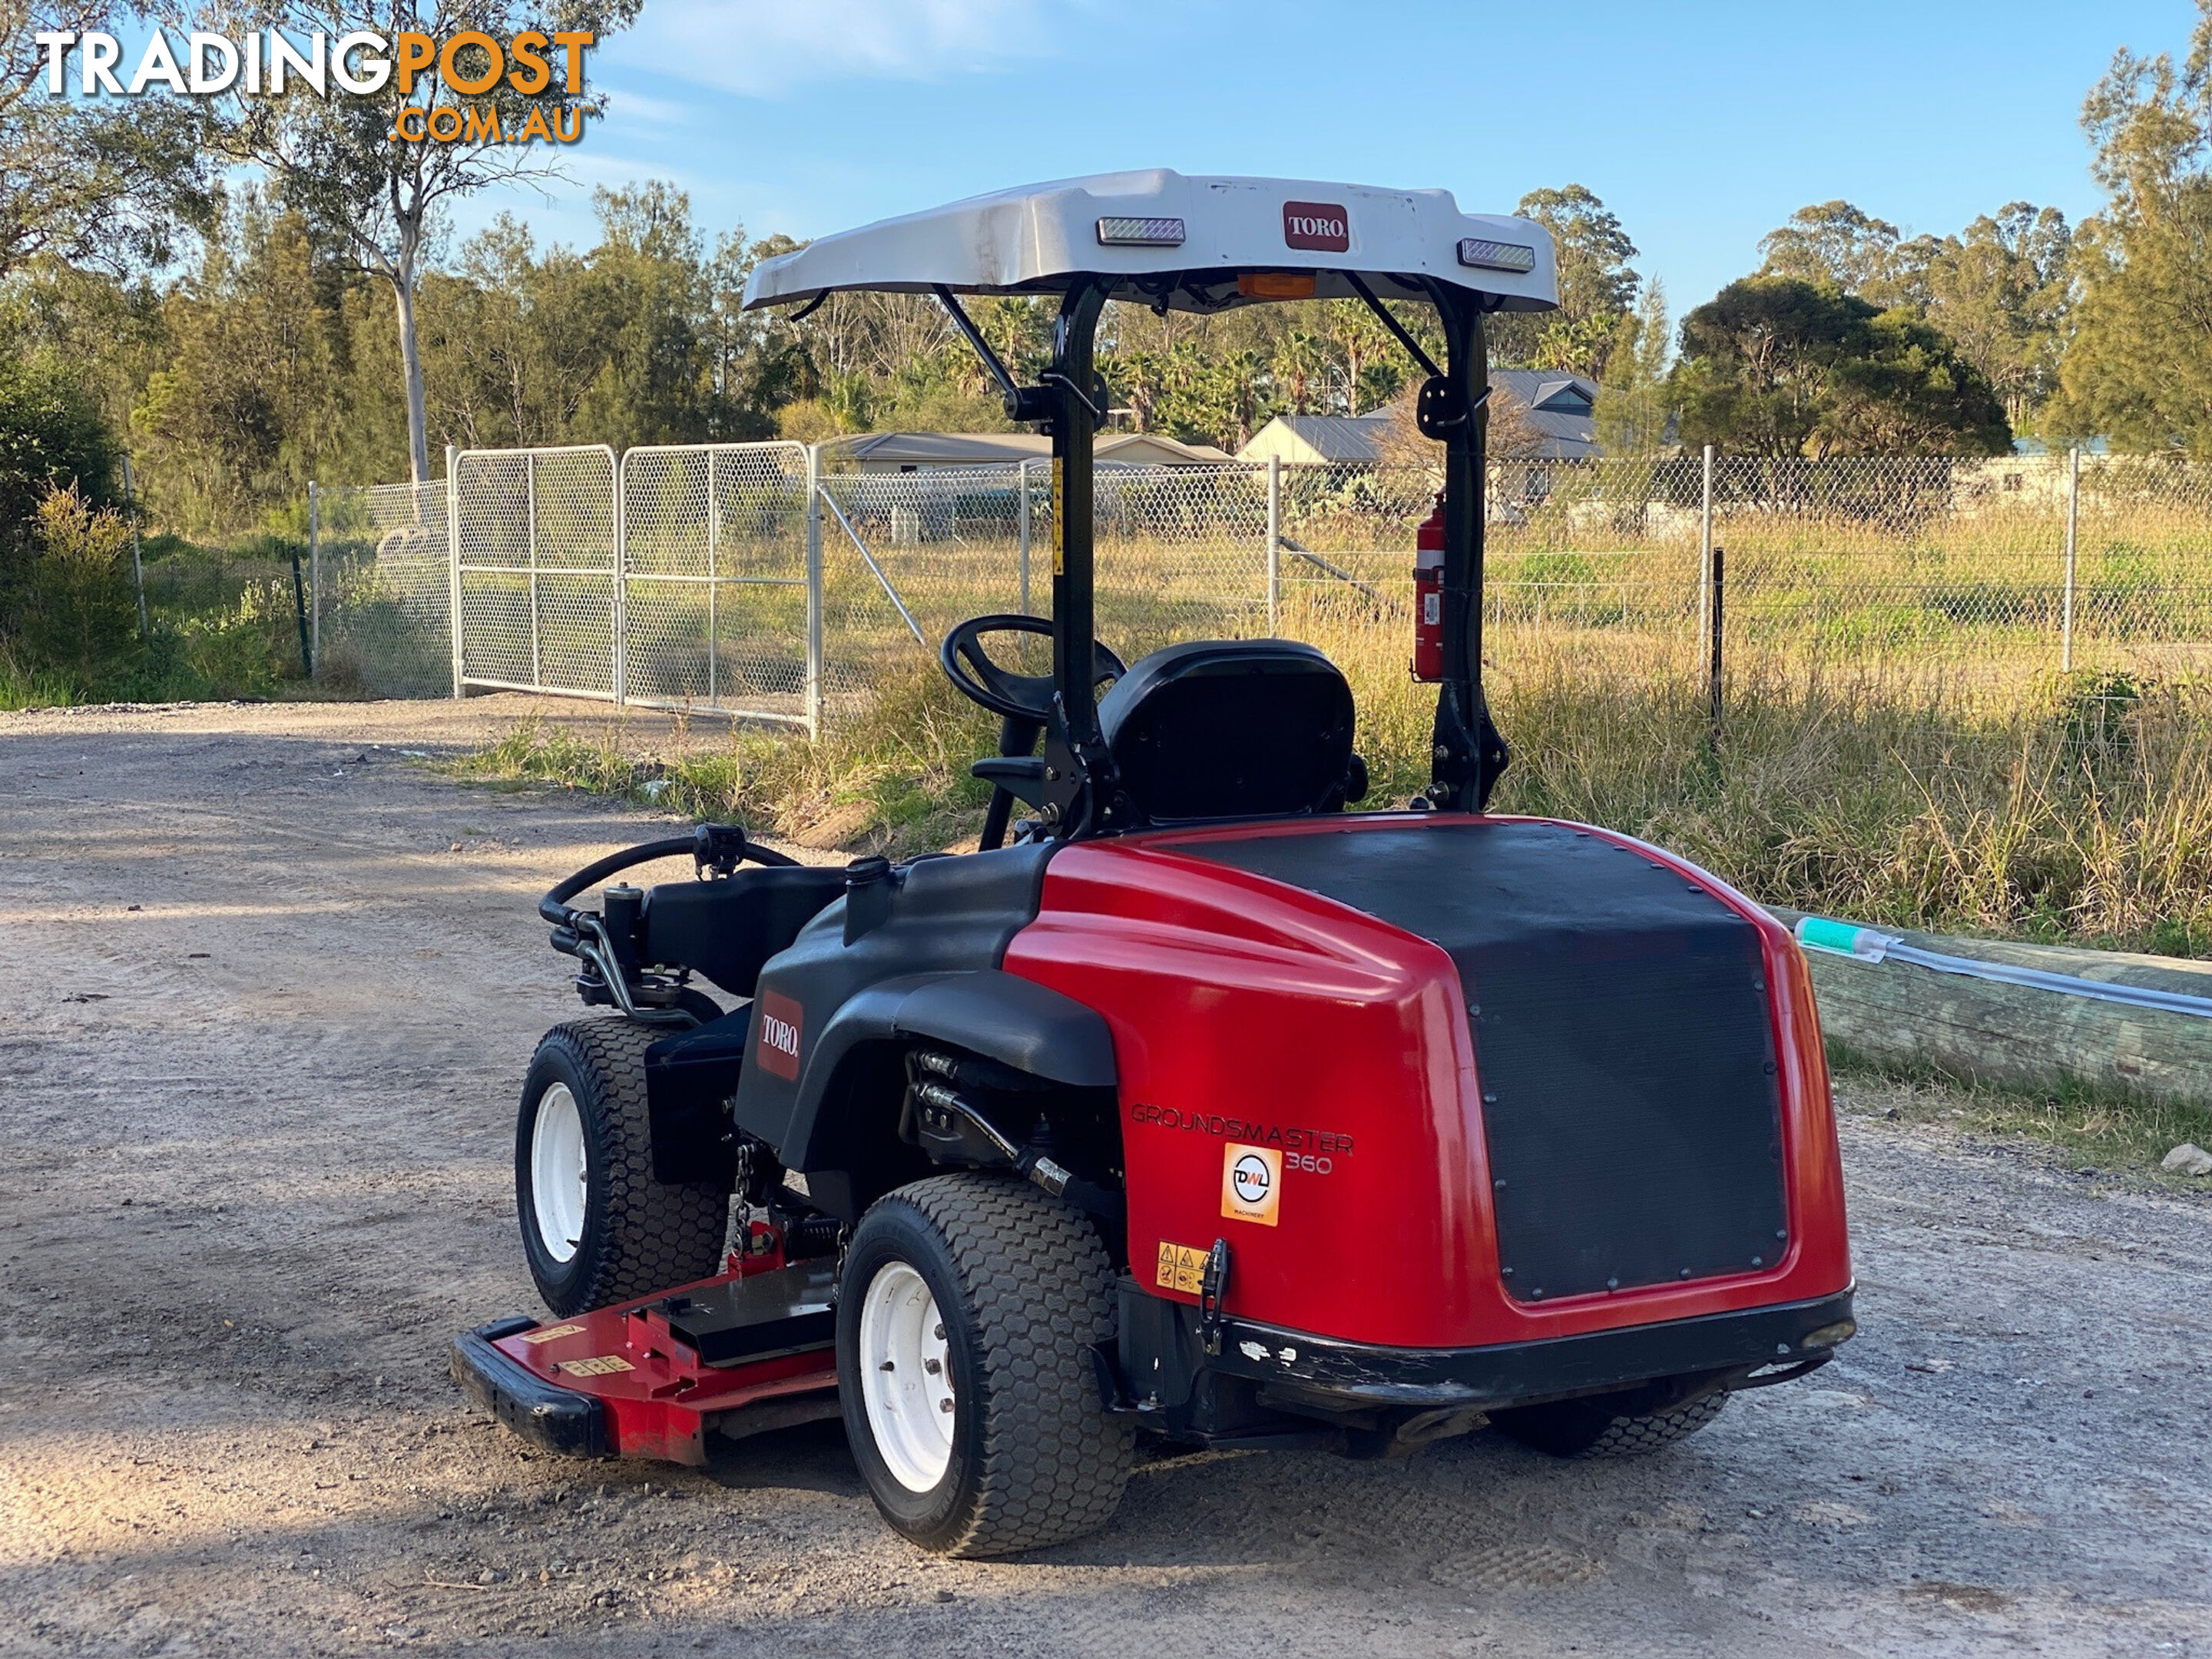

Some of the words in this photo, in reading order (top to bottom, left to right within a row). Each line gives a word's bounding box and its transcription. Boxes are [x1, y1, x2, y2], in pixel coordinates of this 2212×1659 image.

[1288, 217, 1344, 237] TORO
[763, 1014, 798, 1057] TORO
[1131, 1103, 1354, 1157] GROUNDSMASTER
[1285, 1151, 1333, 1175] 360
[1233, 1169, 1270, 1187] DWL
[1233, 1208, 1264, 1219] MACHINERY
